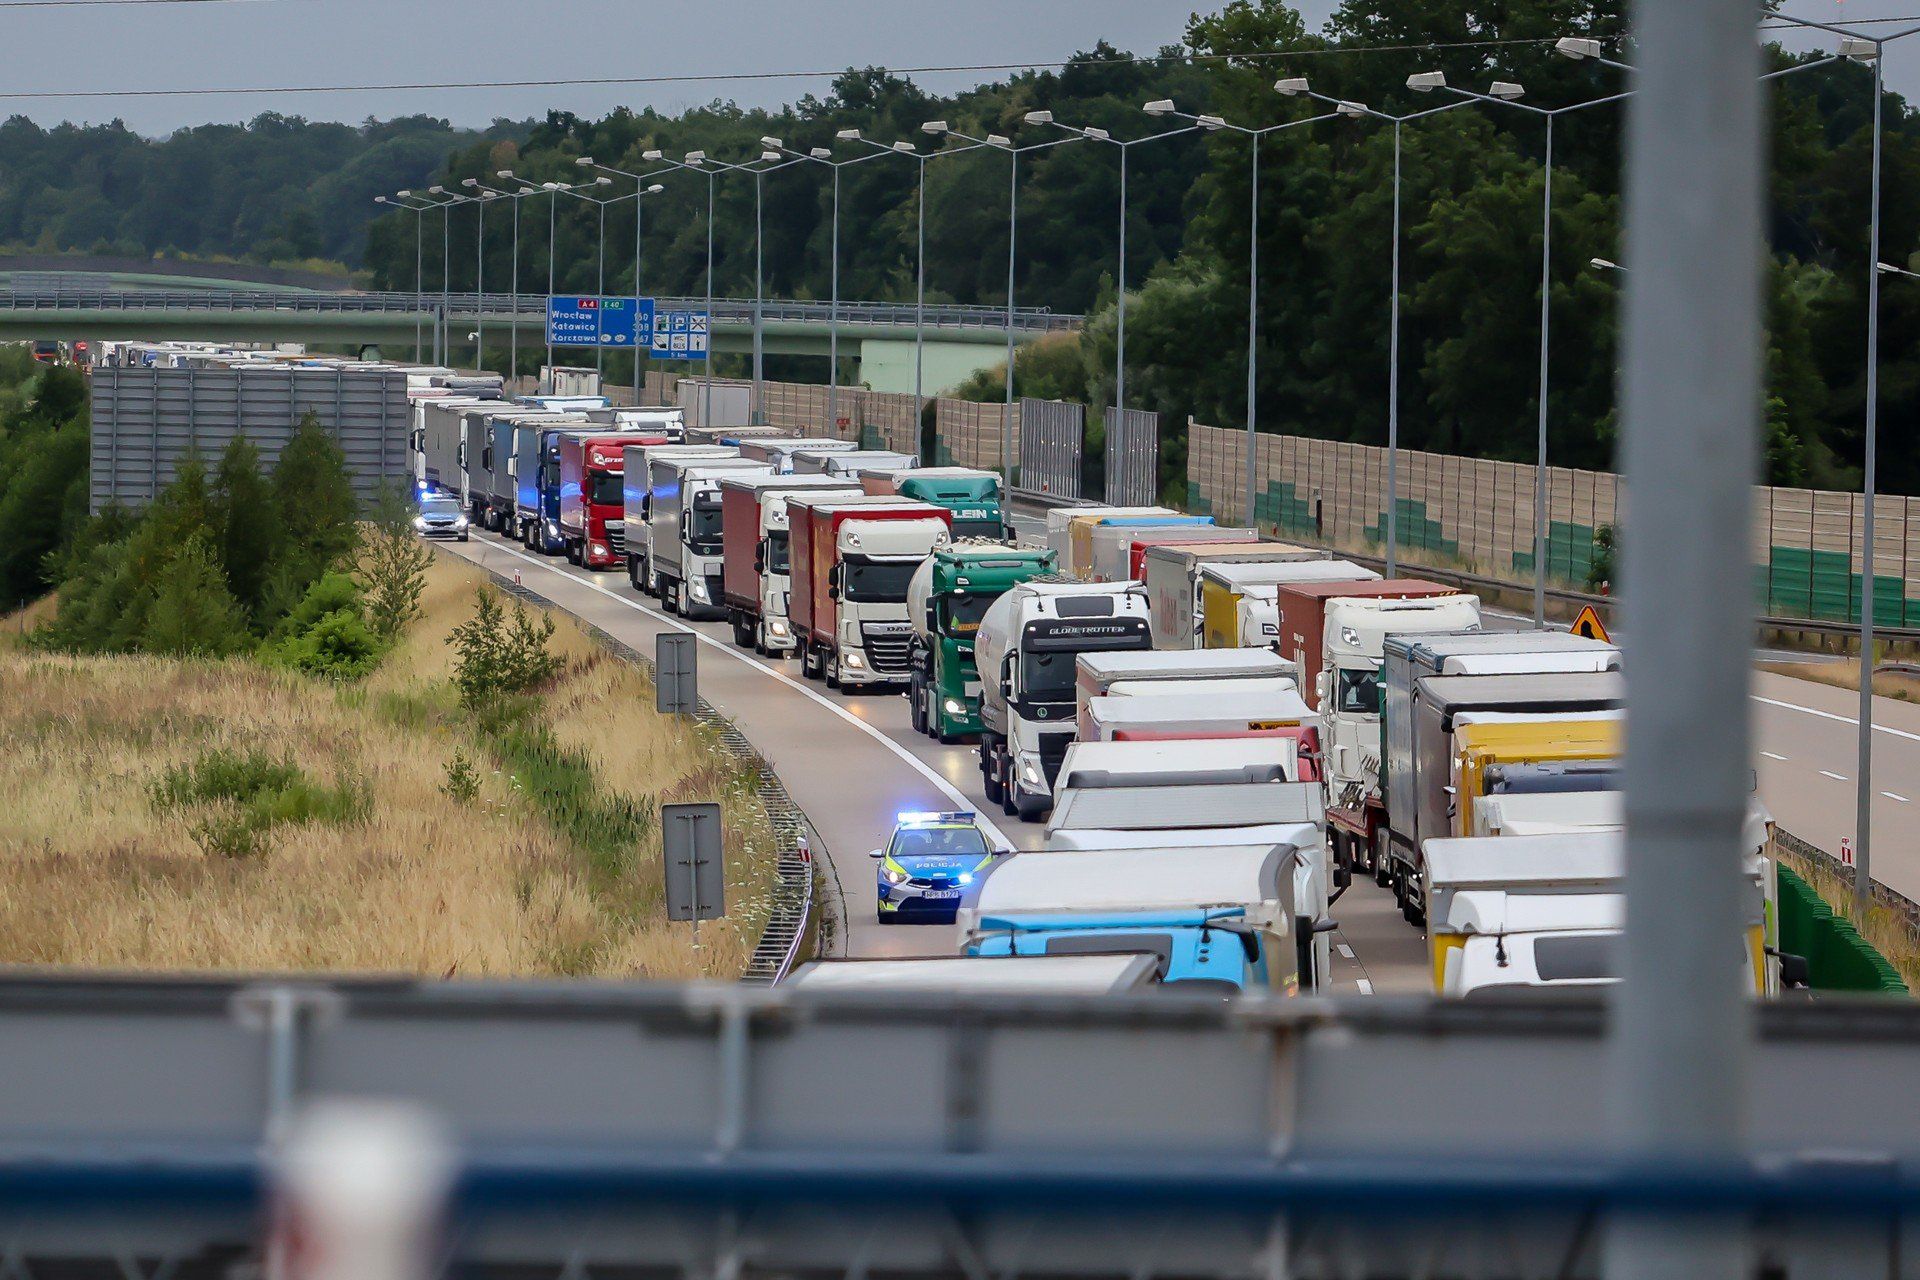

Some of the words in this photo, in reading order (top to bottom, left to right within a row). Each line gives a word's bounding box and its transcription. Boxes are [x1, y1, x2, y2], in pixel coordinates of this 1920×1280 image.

[551, 310, 593, 320] Wrocław
[551, 321, 596, 331] Katowice
[950, 509, 987, 519] LEIN
[1049, 626, 1125, 635] GLOBETROTTER
